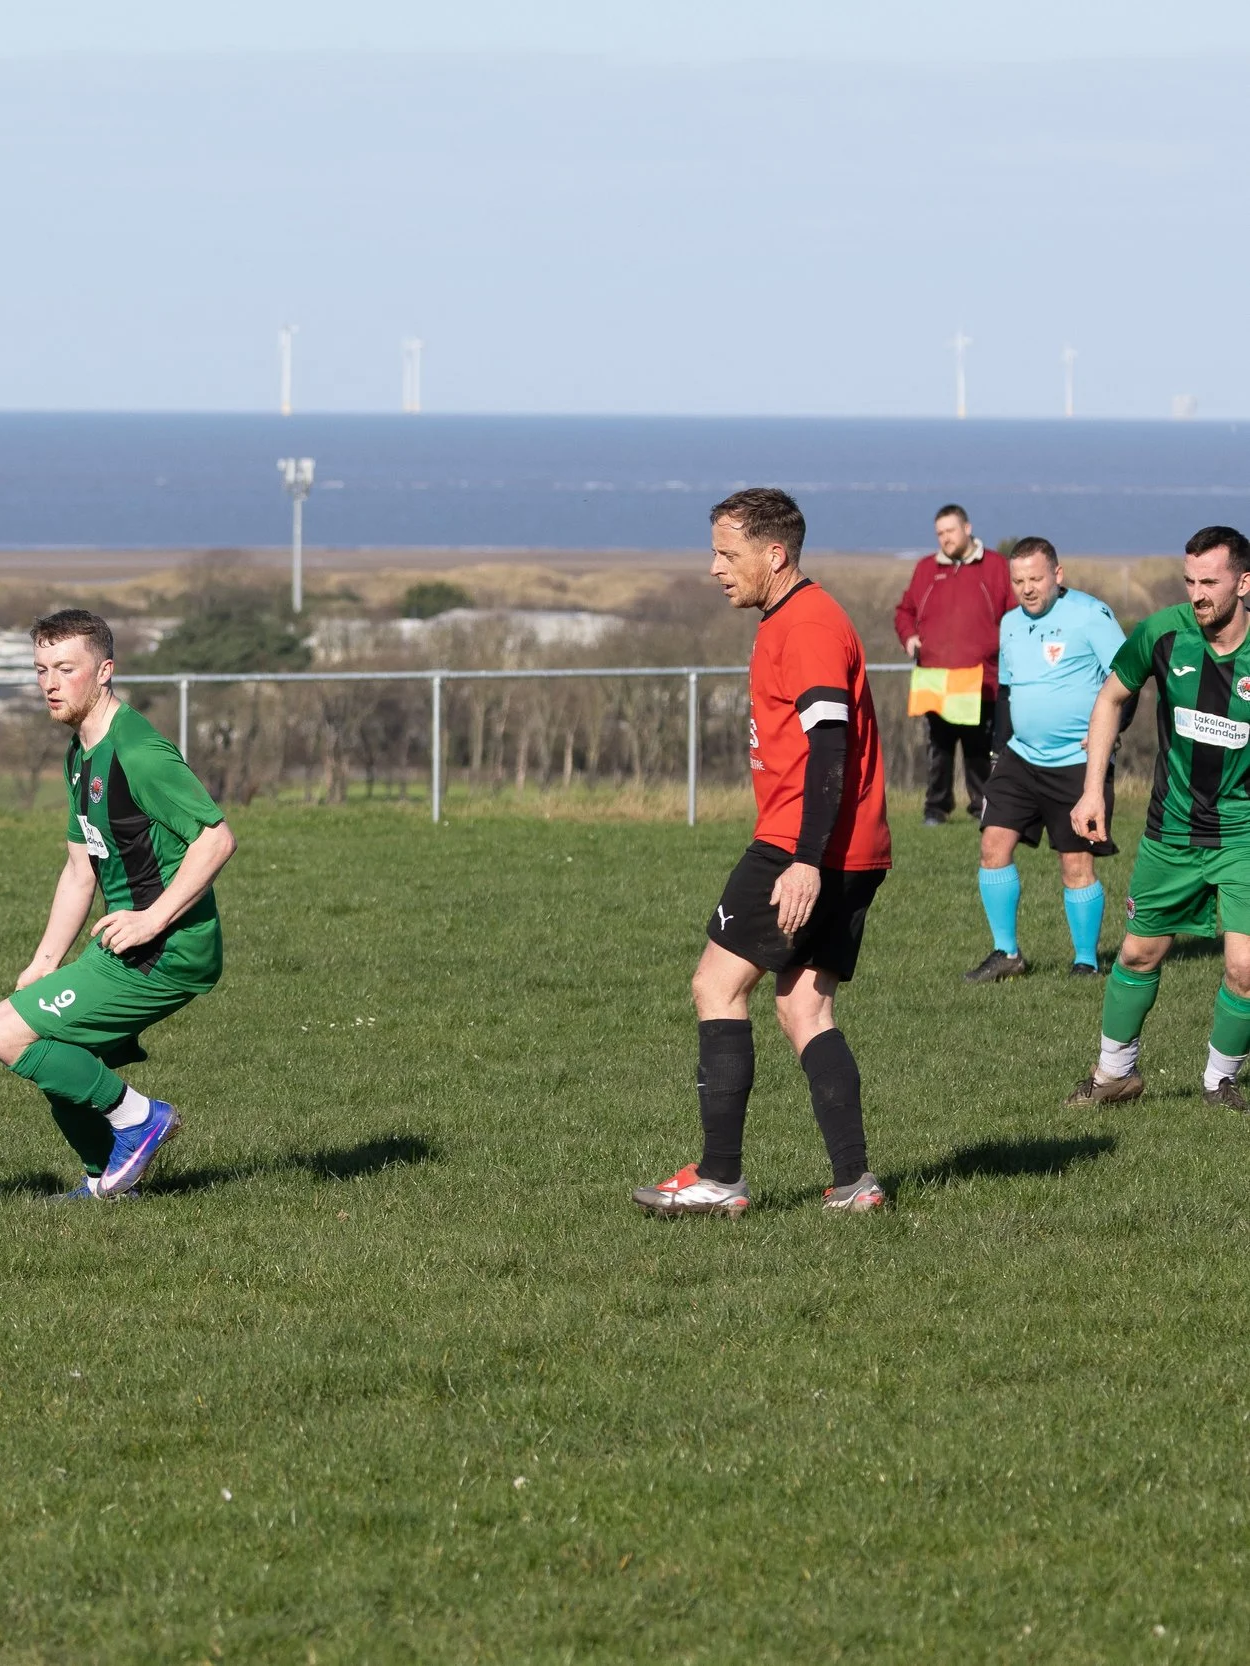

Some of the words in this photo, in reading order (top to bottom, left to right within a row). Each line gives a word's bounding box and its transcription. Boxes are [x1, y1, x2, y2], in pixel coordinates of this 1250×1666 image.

[1194, 713, 1237, 732] Lakeland
[1194, 722, 1247, 740] Verandahs
[54, 989, 76, 1008] 9
